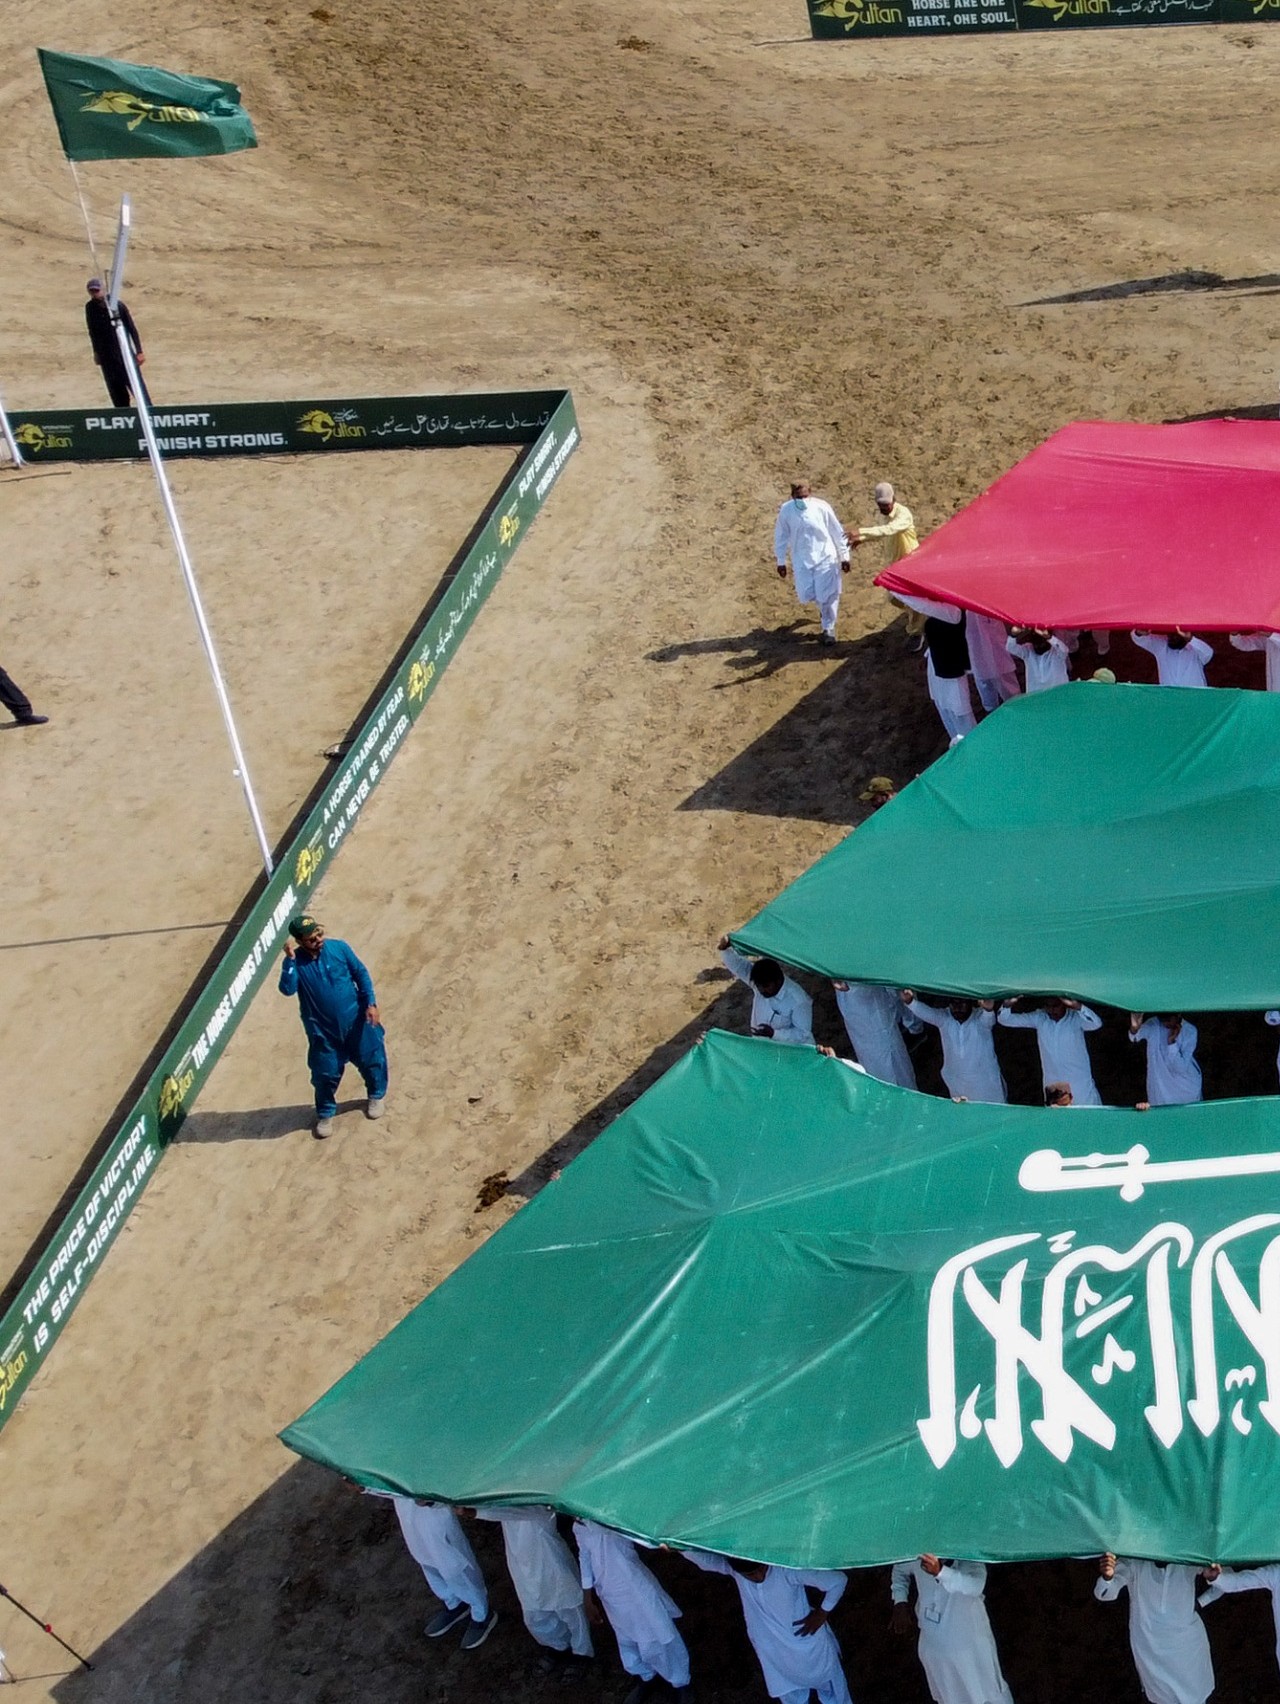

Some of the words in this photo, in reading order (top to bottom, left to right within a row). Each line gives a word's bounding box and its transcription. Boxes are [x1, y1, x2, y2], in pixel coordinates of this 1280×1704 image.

[907, 15, 951, 27] HEART,
[981, 12, 1015, 24] SOUL.
[912, 0, 950, 10] HORSE
[954, 0, 978, 8] ARE
[85, 416, 136, 430] PLAY
[138, 437, 201, 451] FNISH
[205, 433, 288, 448] STRONG.
[323, 807, 332, 825] A
[329, 769, 353, 813] HORSE
[350, 726, 380, 776] TRAINED
[378, 711, 388, 733] BY
[386, 686, 404, 719] FEAR
[328, 815, 346, 849] CAN
[345, 778, 370, 821] NEVER
[369, 760, 380, 782] BE
[191, 1032, 210, 1070] THE
[23, 1277, 50, 1325] THE
[48, 1217, 87, 1286] PRICE
[84, 1190, 101, 1226] OF
[99, 1114, 147, 1198] VICTORY
[33, 1321, 49, 1354] IS
[50, 1143, 156, 1324] SELF-DISCIPLINE.
